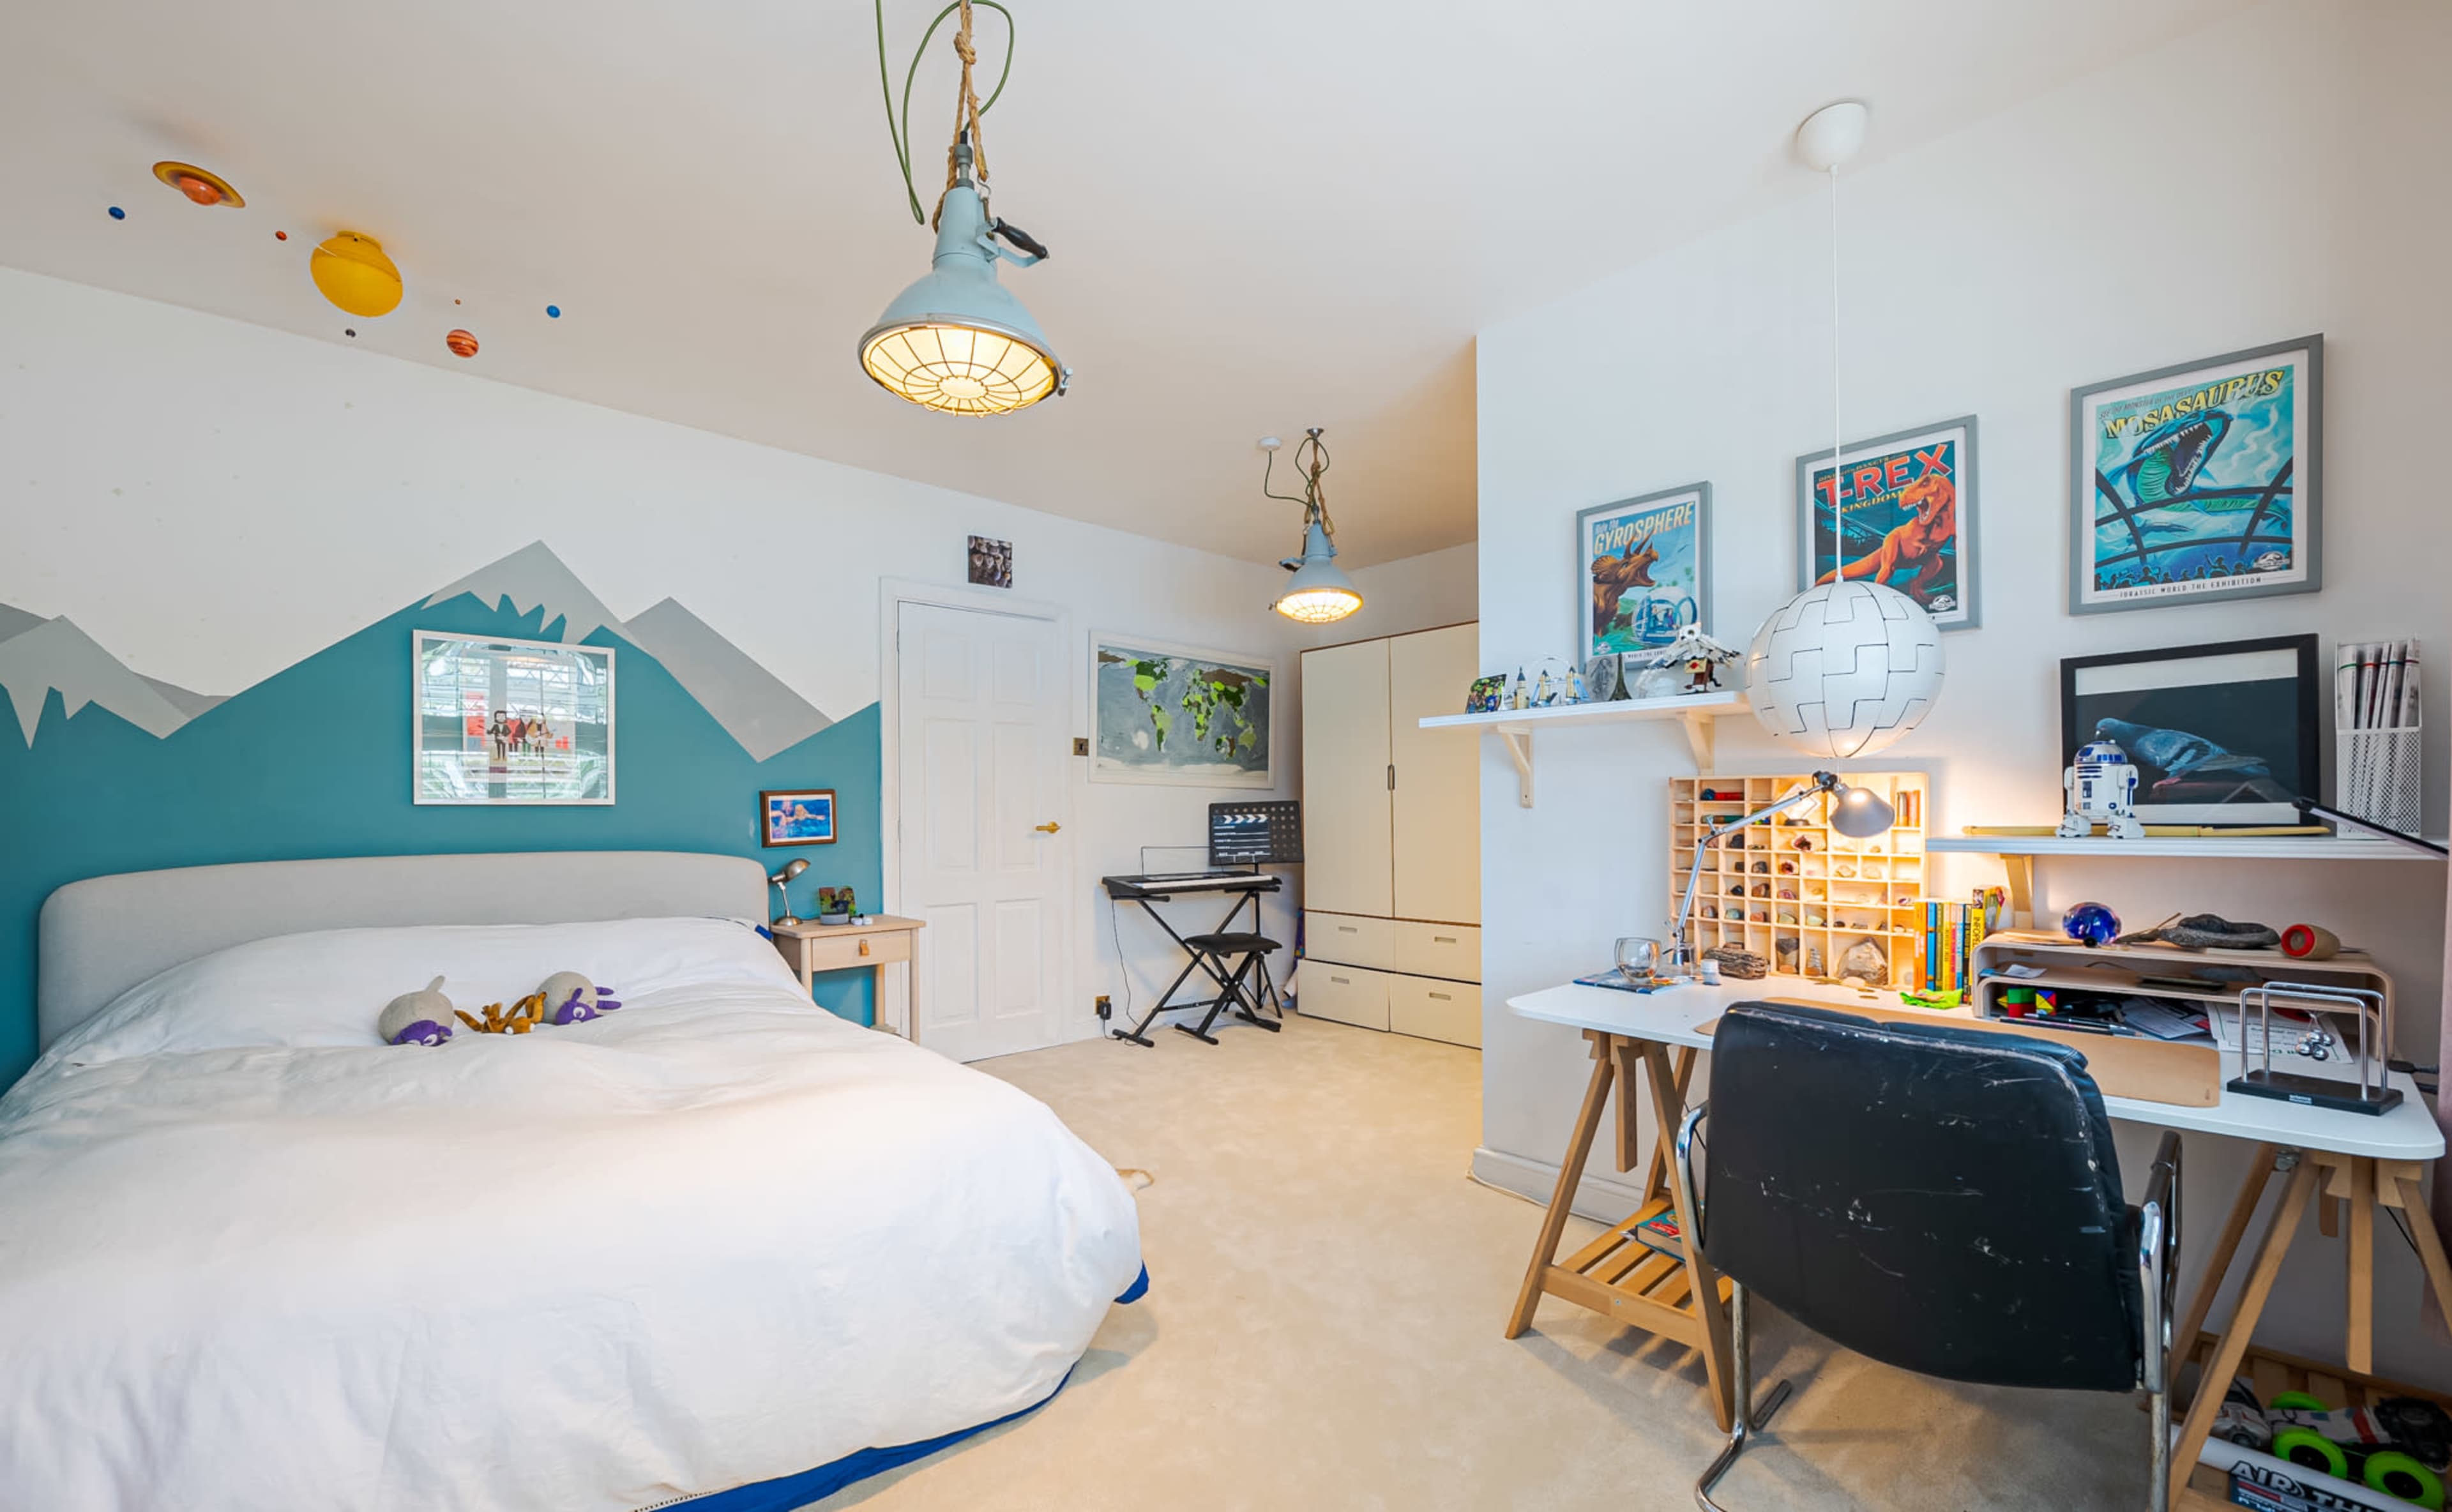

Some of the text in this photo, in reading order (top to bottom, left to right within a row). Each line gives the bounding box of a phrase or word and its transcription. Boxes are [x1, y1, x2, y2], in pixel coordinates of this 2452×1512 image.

[2104, 370, 2284, 439] MOSASAURUS
[1817, 444, 1953, 508] T-REX
[1594, 502, 1695, 555] GYROSPHERE
[2161, 585, 2186, 593] WORLD
[2211, 577, 2262, 589] EXHIBITION
[2231, 1460, 2296, 1495] AIR
